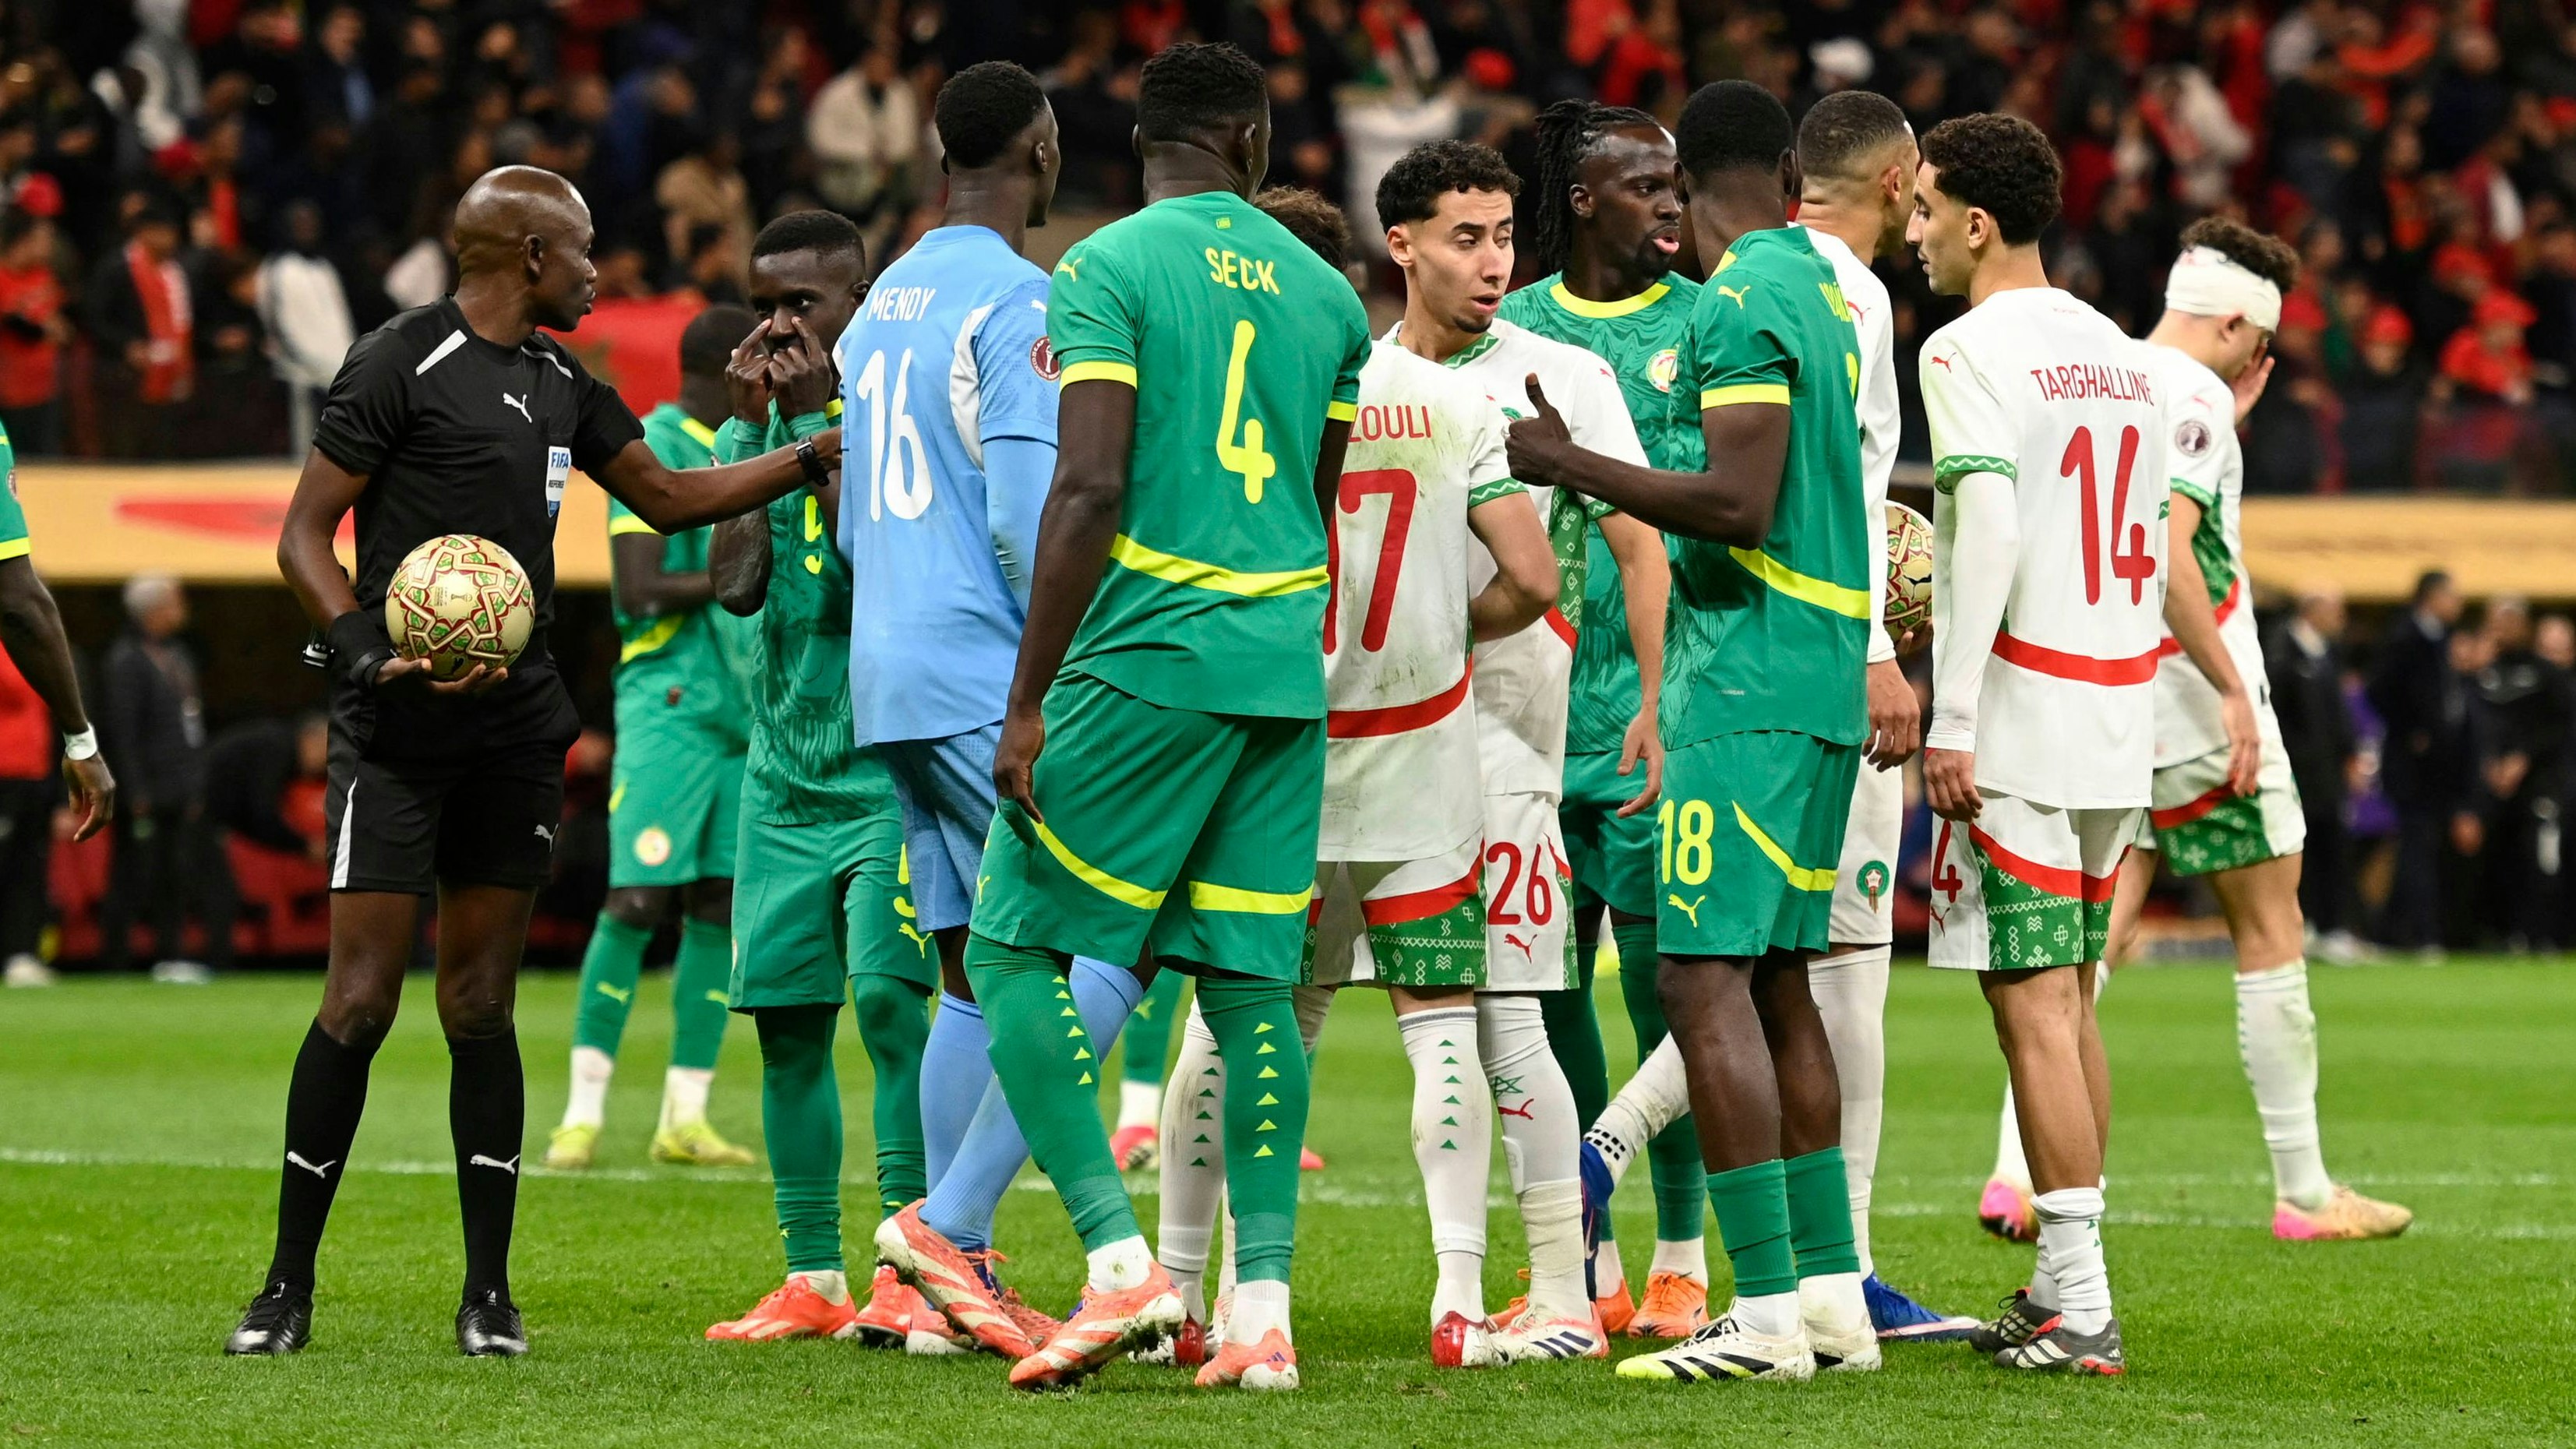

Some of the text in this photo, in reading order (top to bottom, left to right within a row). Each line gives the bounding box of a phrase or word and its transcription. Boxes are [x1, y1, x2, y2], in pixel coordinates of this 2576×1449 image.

[866, 287, 936, 321] MENDY
[1205, 247, 1280, 295] SECK
[1216, 319, 1276, 504] 4
[2030, 364, 2154, 407] TARGHALLINE
[551, 452, 569, 469] FIFA
[856, 348, 933, 523] 16
[2060, 425, 2156, 606] 14
[1486, 841, 1552, 926] 26
[1657, 799, 1714, 886] 18
